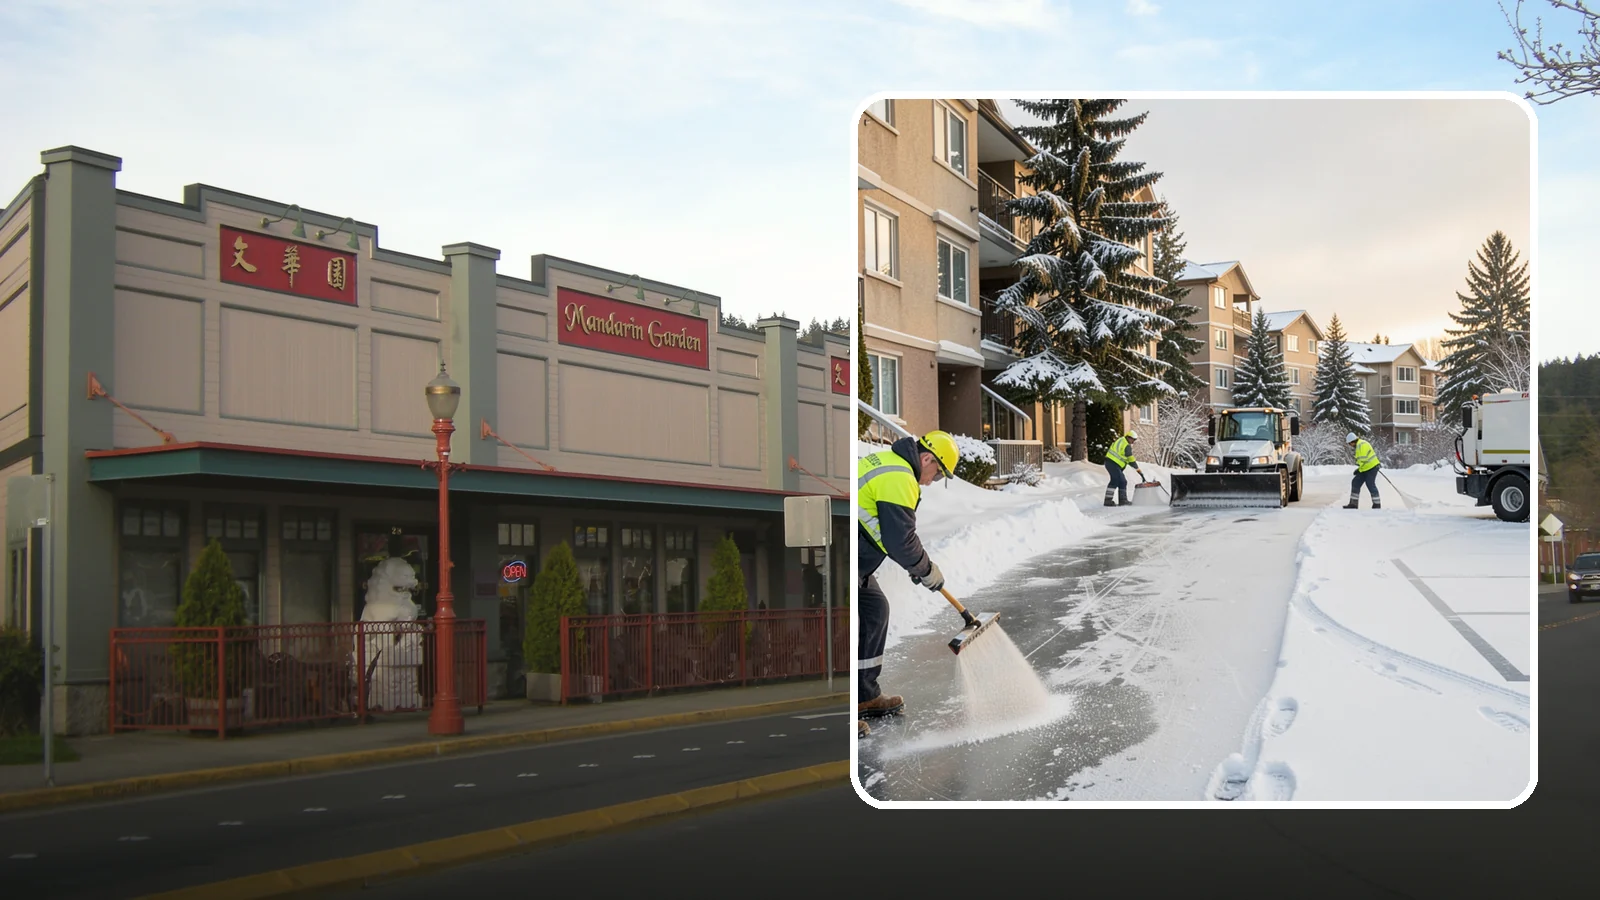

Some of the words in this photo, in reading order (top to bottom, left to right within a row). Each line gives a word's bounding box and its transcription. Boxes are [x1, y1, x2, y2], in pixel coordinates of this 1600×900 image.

[231, 236, 346, 291] 文華園
[564, 302, 644, 341] Mandarin
[647, 320, 701, 352] Garden
[503, 565, 526, 578] OPEN
